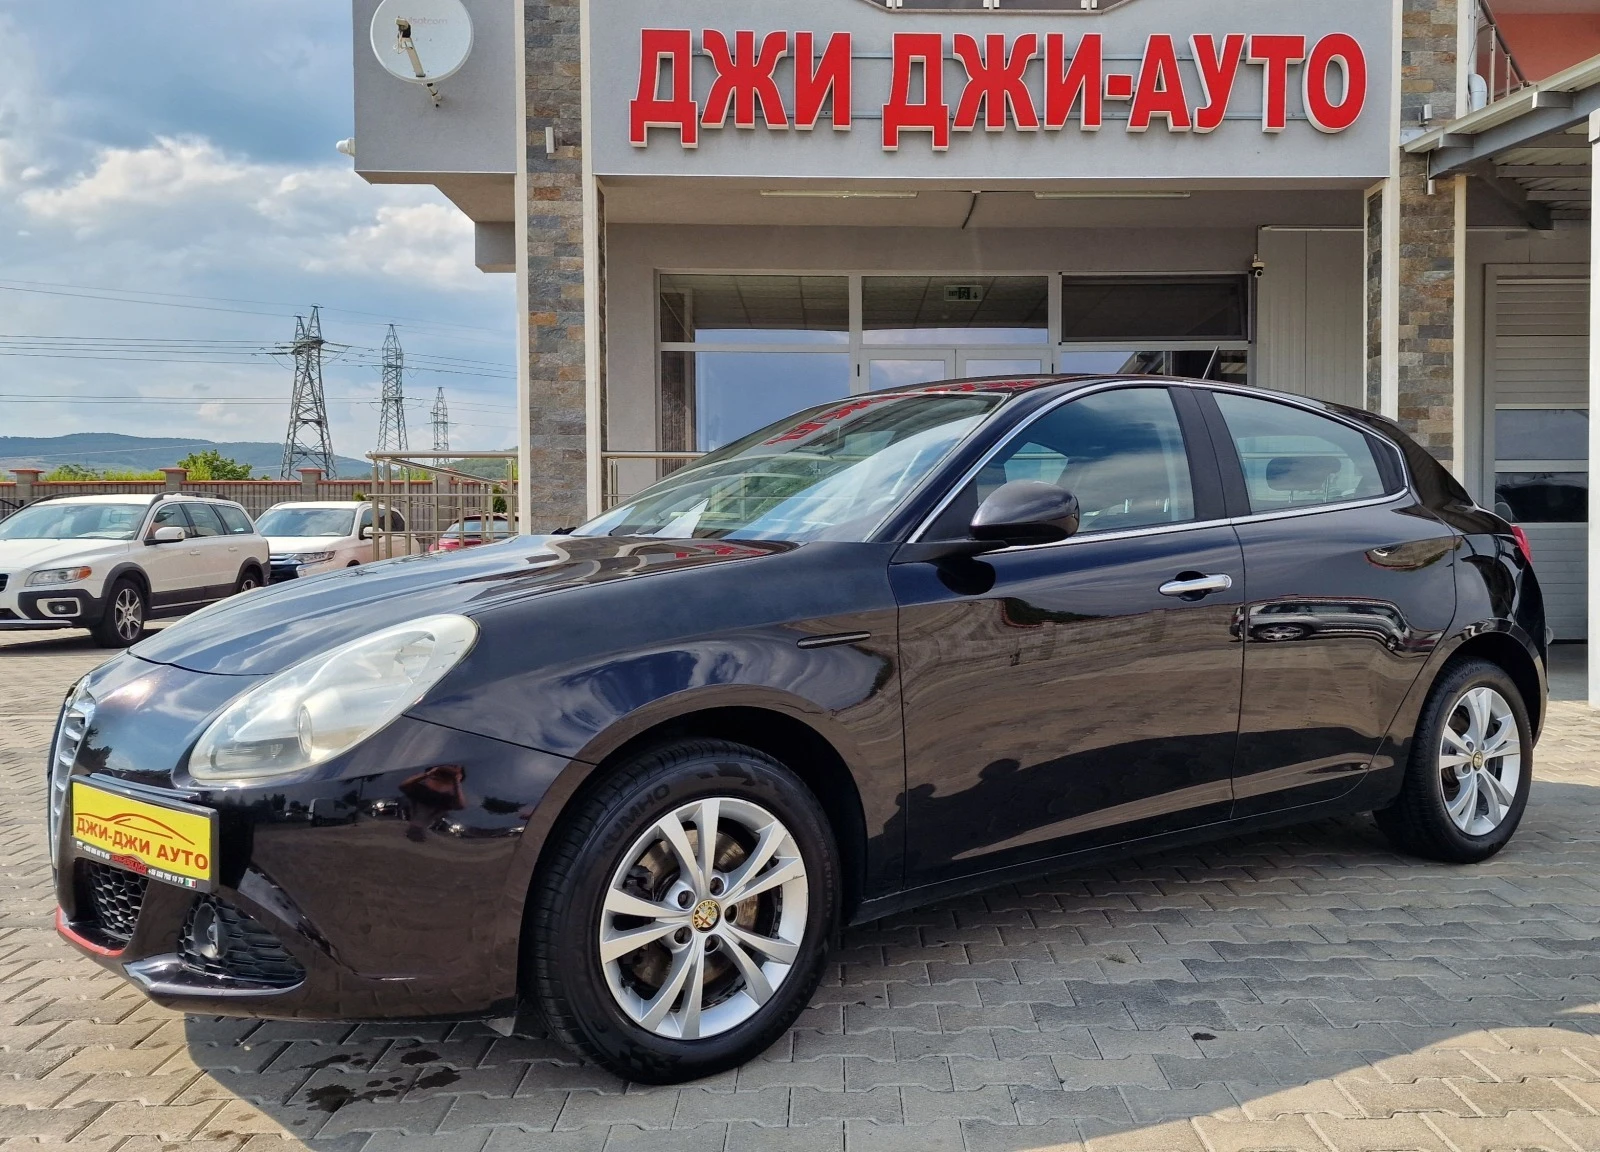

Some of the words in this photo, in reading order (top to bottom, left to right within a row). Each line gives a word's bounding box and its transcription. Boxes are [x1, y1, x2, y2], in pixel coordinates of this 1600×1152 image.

[629, 28, 852, 148] ДЖИ
[882, 31, 1367, 151] ДЖИ-АУТО
[76, 817, 150, 855] ДЖИ-ДЖИ
[156, 845, 209, 870] АУТО
